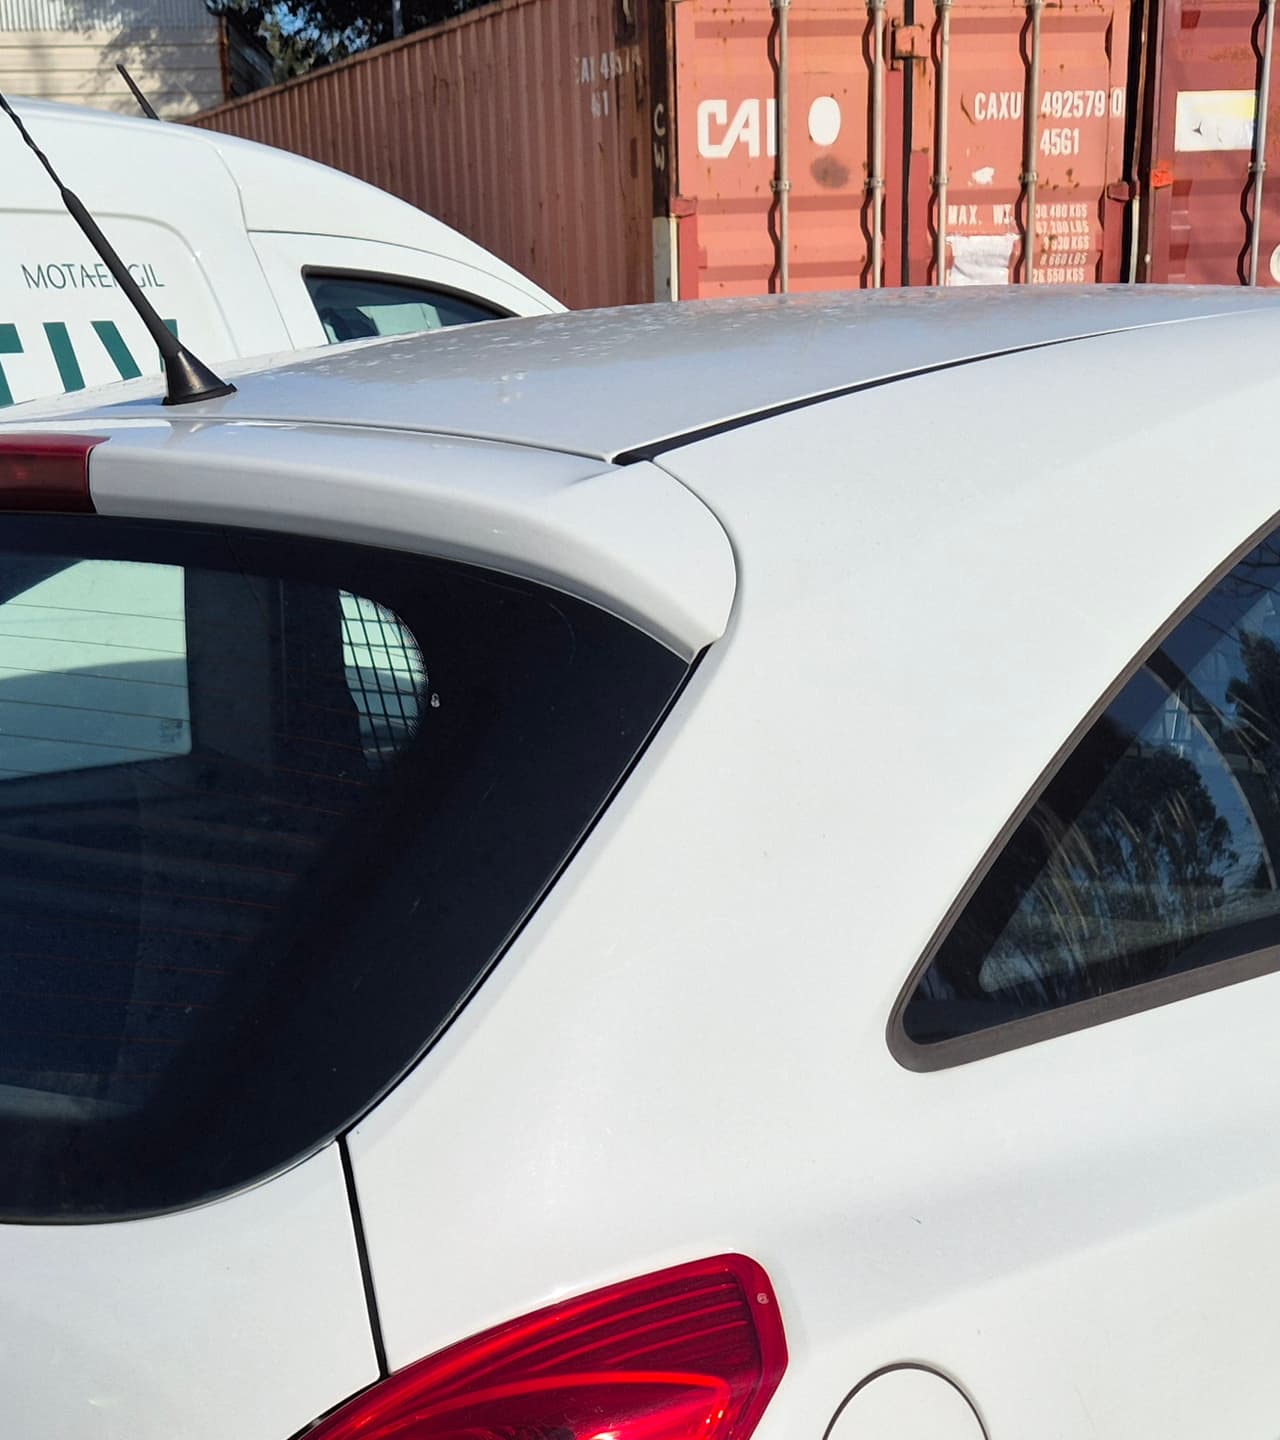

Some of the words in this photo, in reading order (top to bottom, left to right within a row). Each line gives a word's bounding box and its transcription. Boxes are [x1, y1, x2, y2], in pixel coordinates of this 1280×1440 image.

[974, 91, 1021, 120] CAXU
[1040, 89, 1106, 119] 492579
[697, 98, 777, 158] CAI
[947, 205, 982, 226] MAX.
